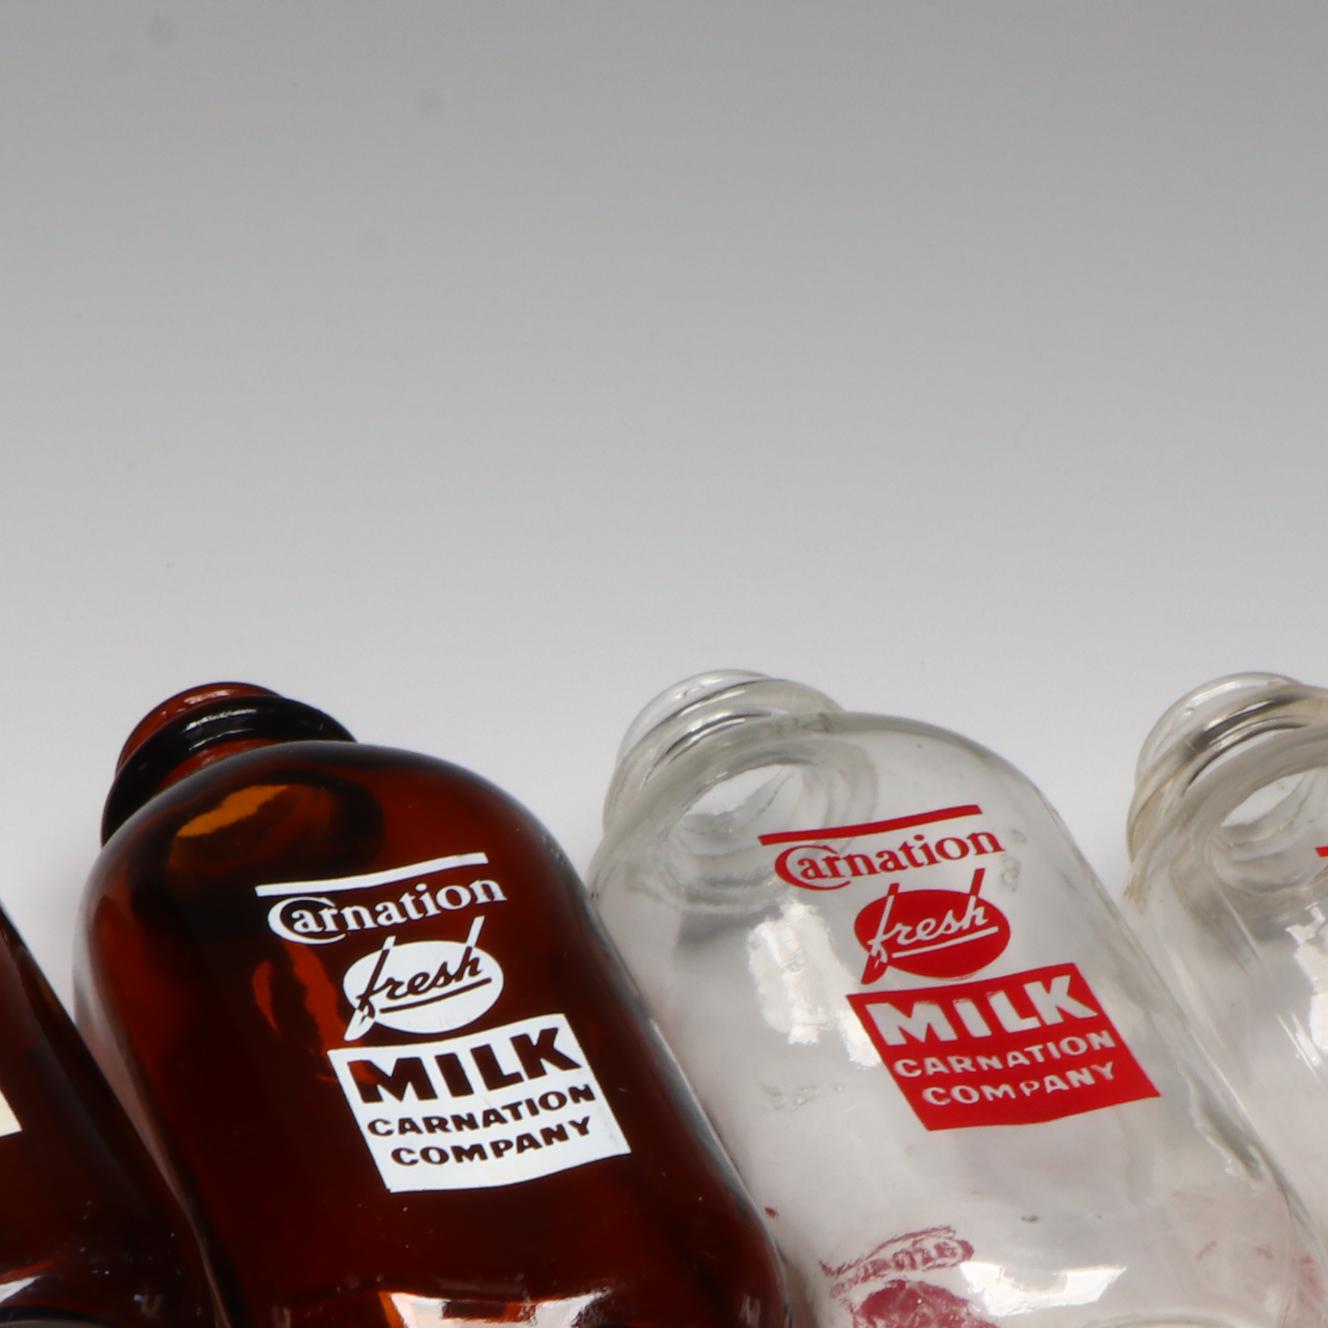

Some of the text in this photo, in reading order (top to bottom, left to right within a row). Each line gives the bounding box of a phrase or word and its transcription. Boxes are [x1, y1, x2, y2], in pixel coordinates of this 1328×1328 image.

[774, 831, 1006, 891] Carnation
[267, 878, 507, 945] Carnation
[860, 867, 986, 985] fresh
[344, 916, 485, 1041] fresh
[865, 975, 1098, 1046] MILK
[346, 1027, 582, 1104] MILK
[893, 1030, 1116, 1078] CARNATION
[921, 1061, 1114, 1106] COMPANY
[367, 1084, 596, 1137] CARNATION
[390, 1116, 591, 1166] COMPANY
